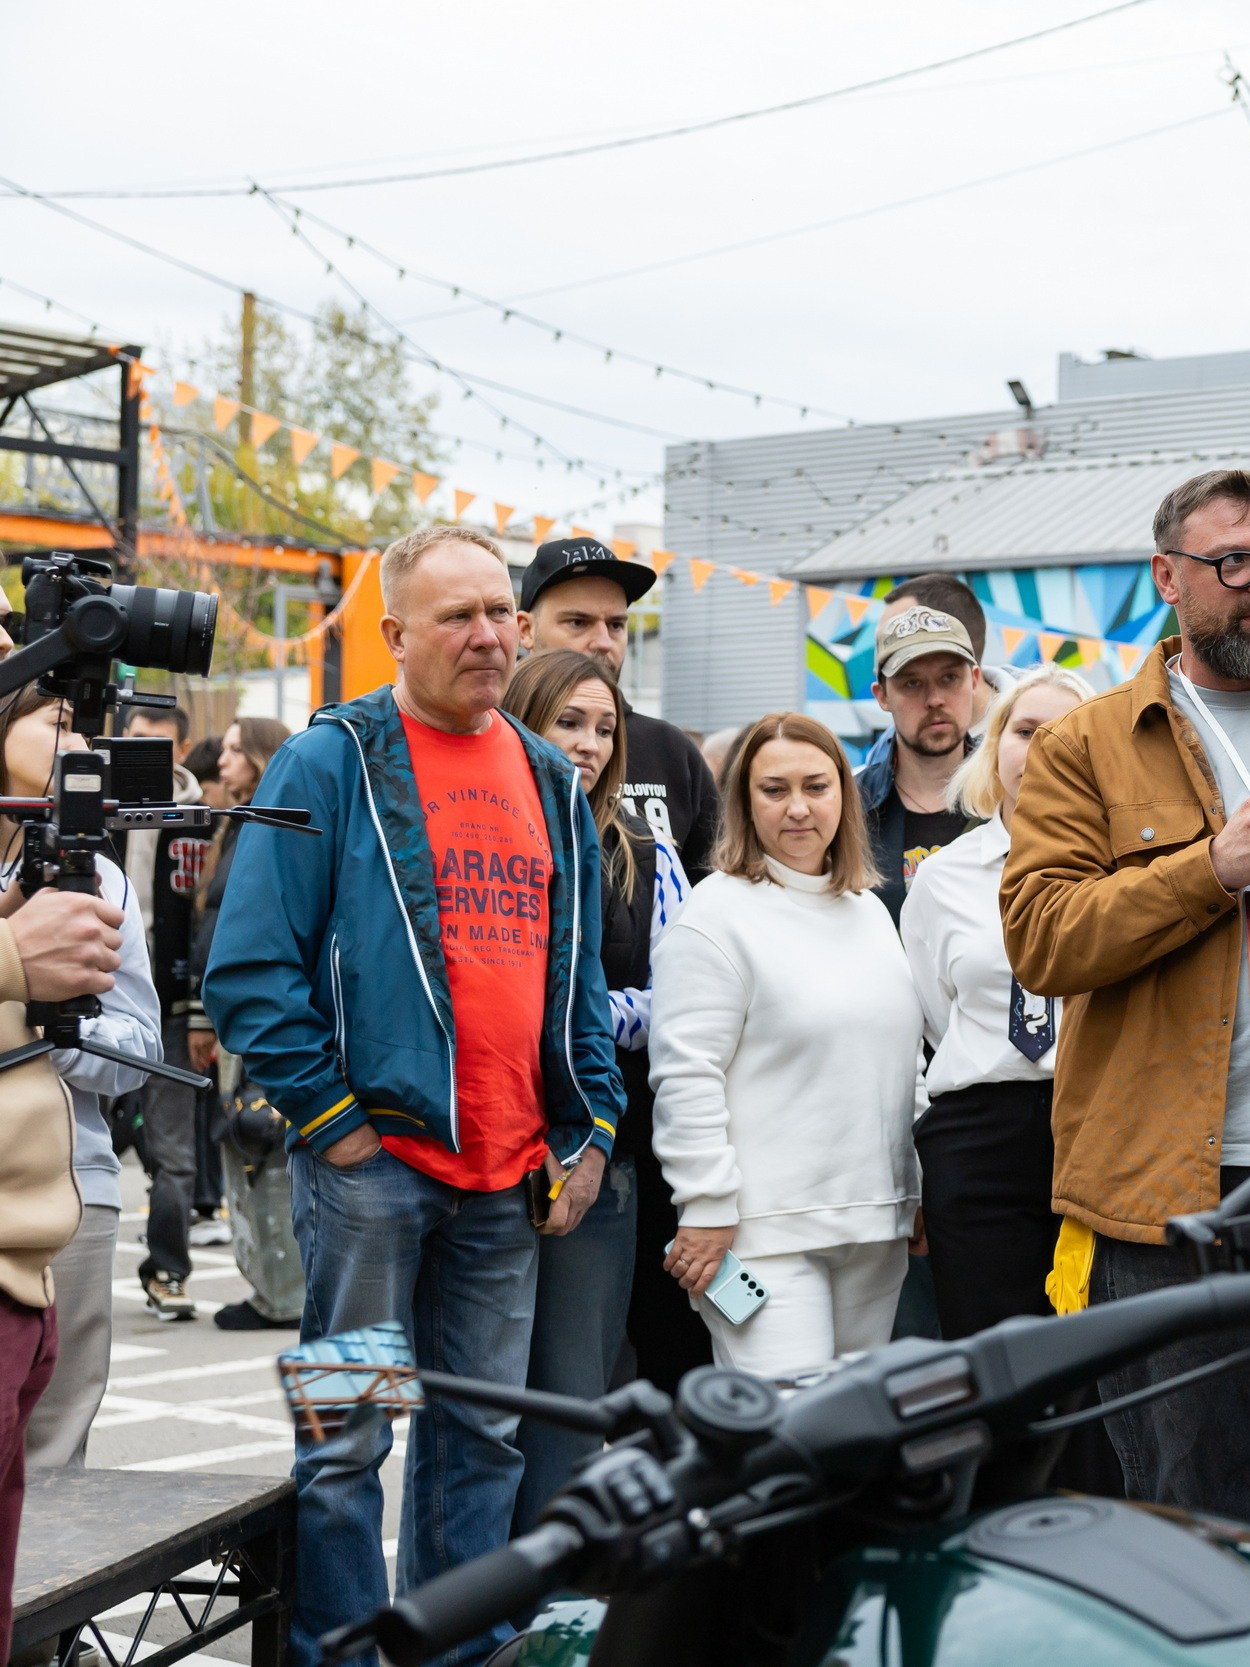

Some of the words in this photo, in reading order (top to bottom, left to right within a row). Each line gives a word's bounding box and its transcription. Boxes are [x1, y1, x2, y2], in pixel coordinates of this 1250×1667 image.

[447, 788, 520, 820] VINTAGE
[528, 822, 553, 866] QUA
[437, 885, 541, 921] ERVICES
[470, 925, 522, 945] MADE
[481, 957, 505, 966] SINCE
